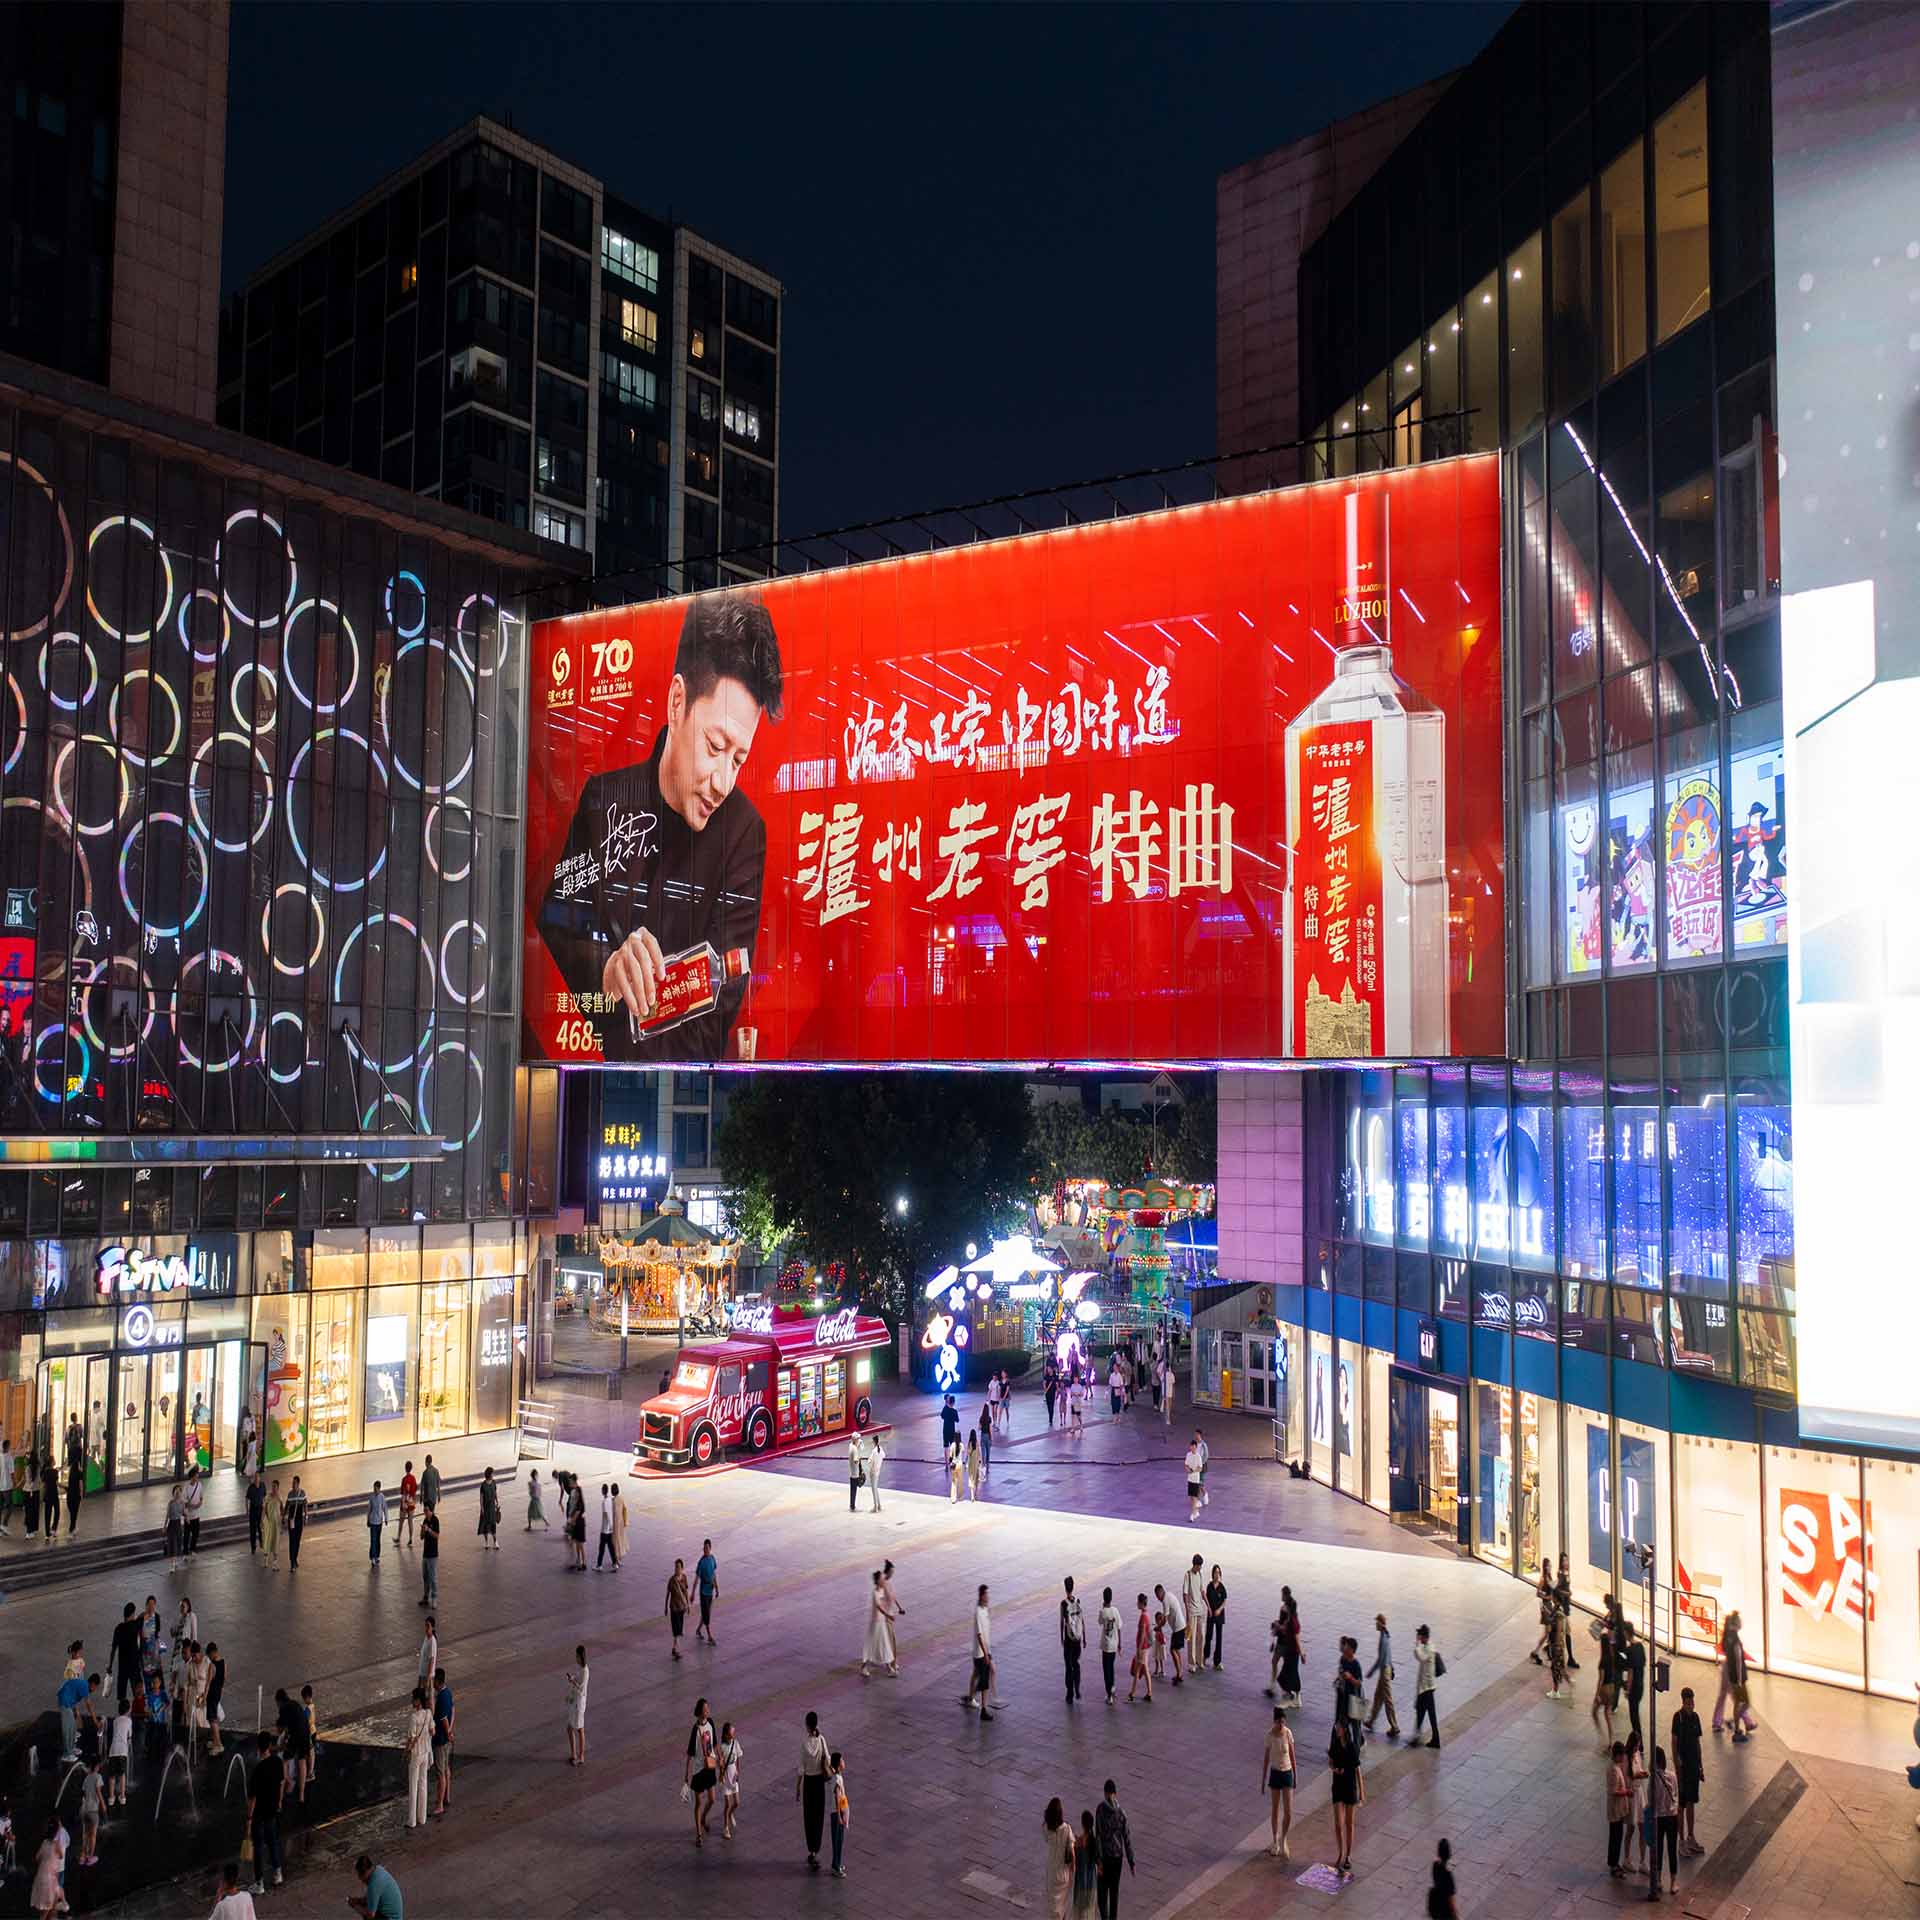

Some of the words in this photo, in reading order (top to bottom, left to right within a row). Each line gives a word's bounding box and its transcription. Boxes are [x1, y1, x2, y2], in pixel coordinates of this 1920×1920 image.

[591, 638, 634, 677] 700
[554, 848, 594, 880] 品牌代言人
[562, 863, 601, 897] 段奕宏
[1304, 884, 1319, 939] 特曲
[556, 992, 616, 1014] 建议零售价
[556, 1020, 604, 1052] 468元
